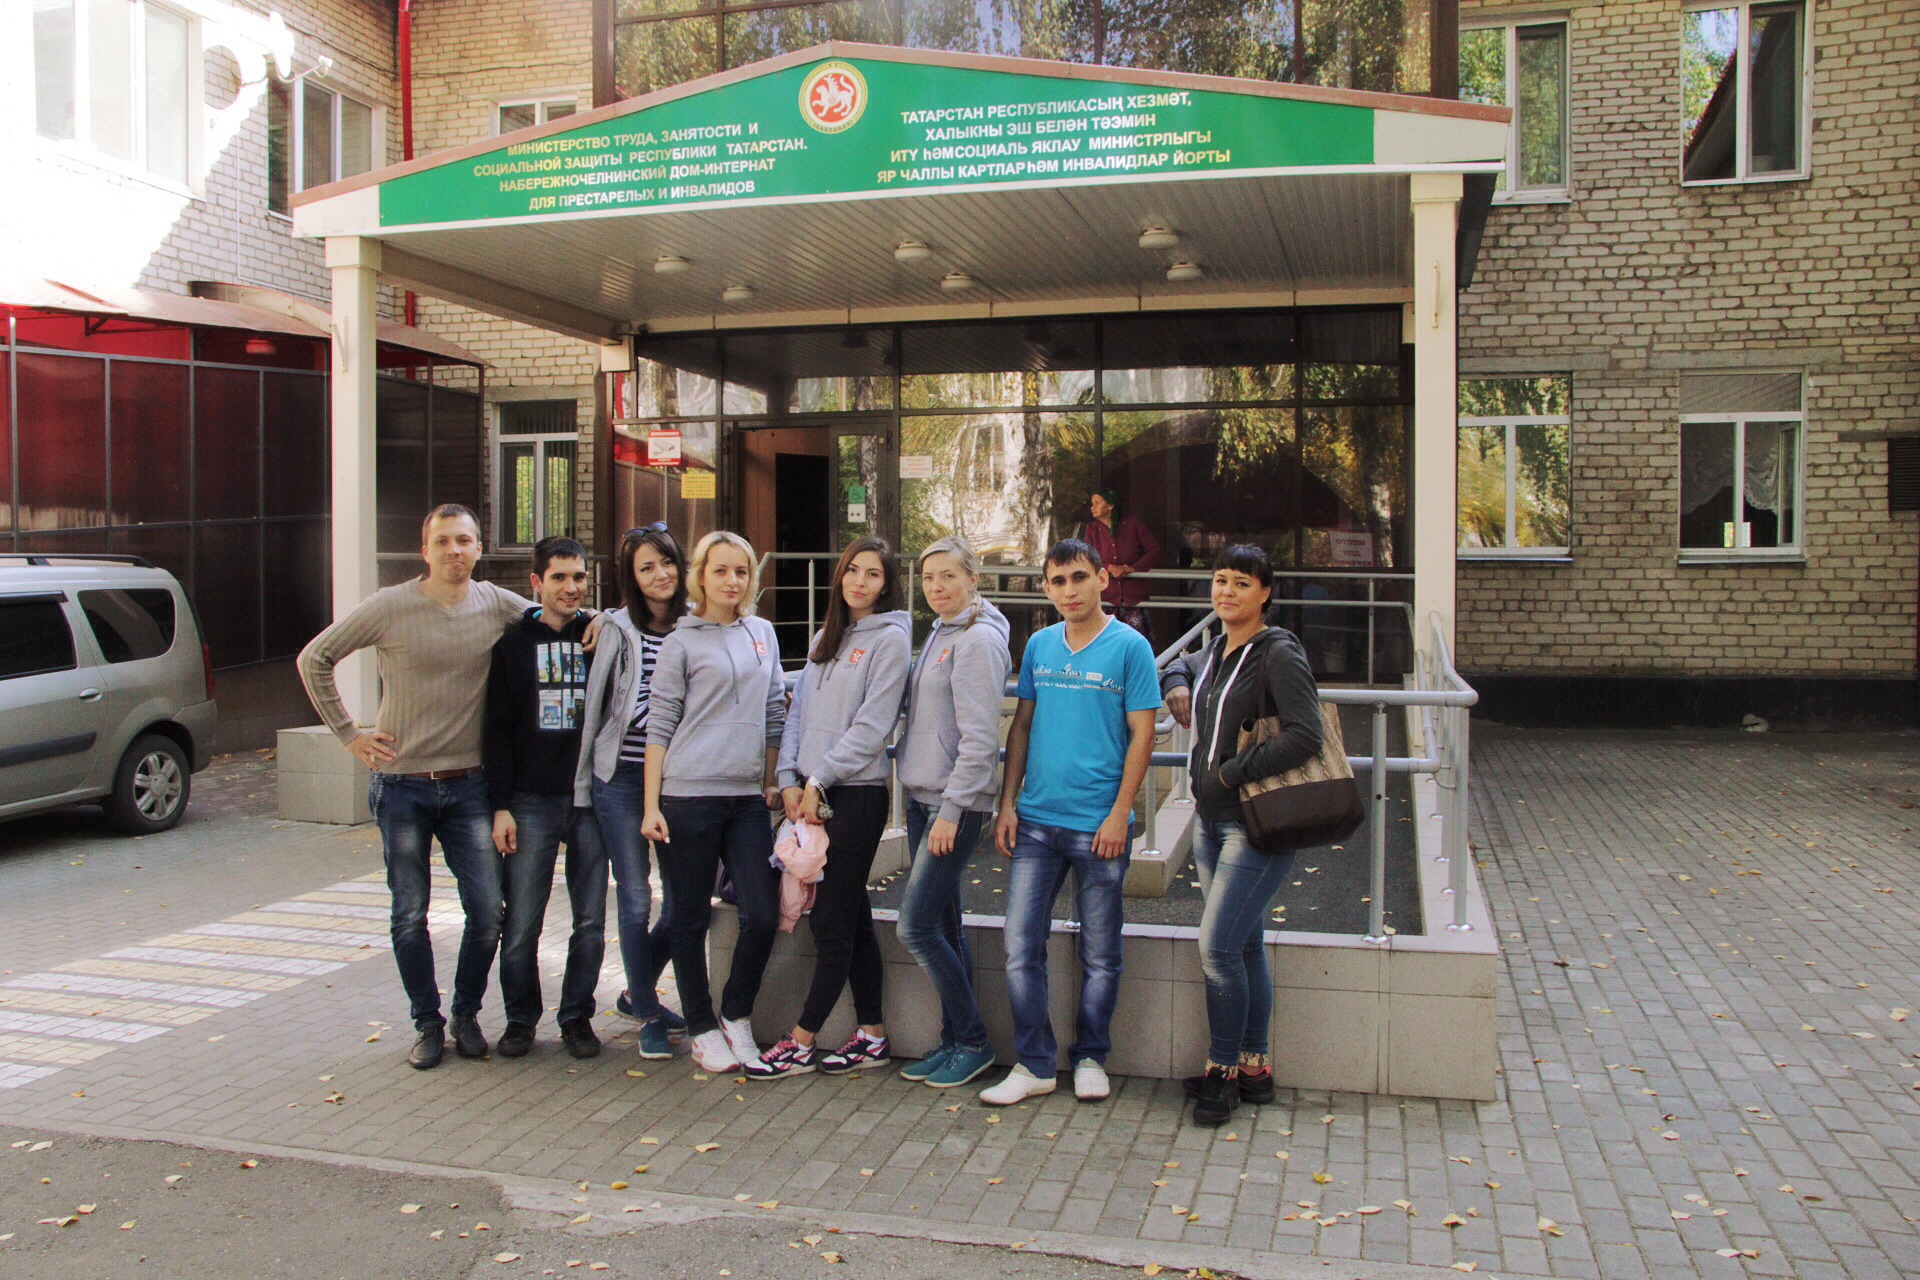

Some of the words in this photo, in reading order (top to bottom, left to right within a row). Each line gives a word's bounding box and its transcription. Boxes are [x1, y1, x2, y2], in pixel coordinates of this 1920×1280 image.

[901, 106, 984, 124] ТАТАРСТАН
[988, 96, 1124, 118] РЕСПУБЛИКАСЫҢ
[1127, 92, 1192, 109] ХЕЗМӘТ,
[508, 136, 610, 156] МИНИСТЕРСТВО
[613, 133, 658, 147] ТРУДА,
[661, 124, 741, 143] ЗАНЯТОСТИ
[749, 123, 758, 135] И
[925, 124, 1003, 141] ХАЛЫКНЫ
[1007, 121, 1031, 136] ЭШ
[1036, 118, 1087, 134] БЕЛӘН
[1091, 113, 1156, 130] ТӘЭМИН
[1031, 138, 1081, 154] ЯКЛАУ
[1089, 130, 1211, 150] МИНИСТРЛЫГЫ
[473, 156, 561, 176] СОЦИАЛЬНОЙ
[564, 153, 622, 169] ЗАЩИТЫ
[629, 145, 717, 163] РЕСПУБЛИКИ
[726, 138, 808, 155] ТАТАРСТАН.
[877, 170, 897, 183] ЯР
[900, 165, 954, 181] ЧАЛЛЫ
[958, 162, 1025, 178] КАРТЛАР
[1063, 153, 1169, 173] ИНВАЛИДЛАР
[1173, 149, 1230, 165] ЙОРТЫ
[499, 165, 667, 192] НАБЕРЕЖНОЧЕЛНИНСКИЙ
[669, 158, 776, 180] ДОМ-ИНТЕРНАТ
[529, 196, 556, 211] ДЛЯ
[559, 188, 655, 207] ПРЕСТАРЕЛЫХ
[658, 187, 667, 200] И
[671, 181, 755, 199] ИНВАЛИДОВ
